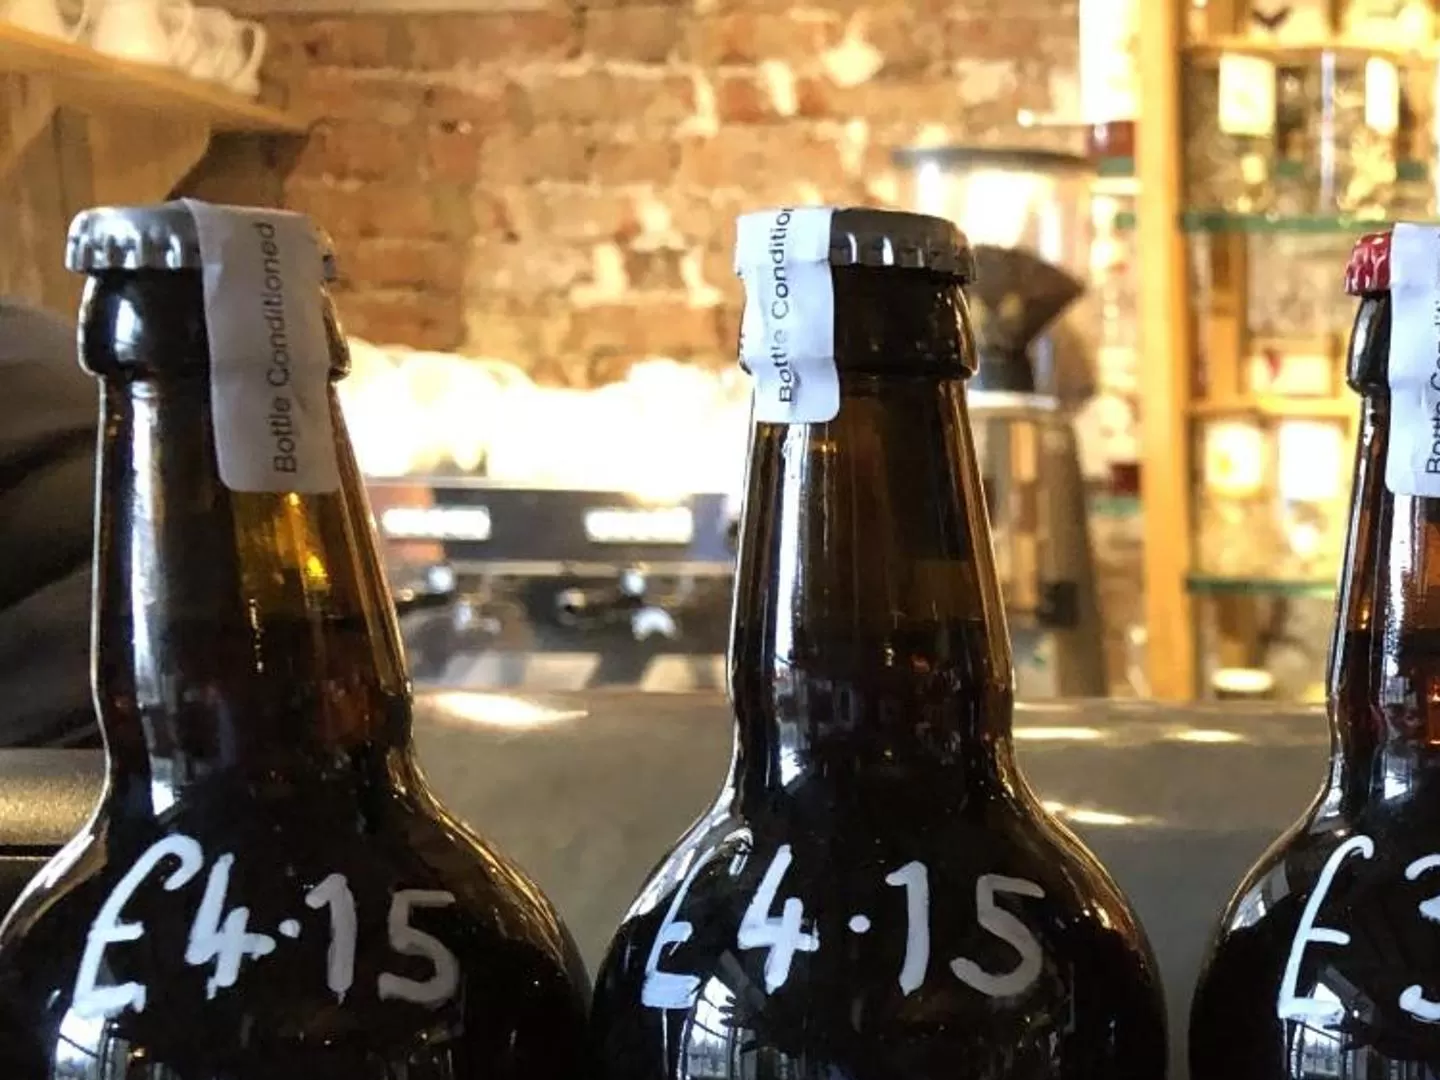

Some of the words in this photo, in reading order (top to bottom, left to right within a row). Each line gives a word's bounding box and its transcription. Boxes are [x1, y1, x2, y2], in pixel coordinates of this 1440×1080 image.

[253, 222, 291, 387] Conditioned
[768, 208, 795, 320] Conditio
[770, 330, 793, 402] Bottle
[266, 397, 298, 474] Bottle
